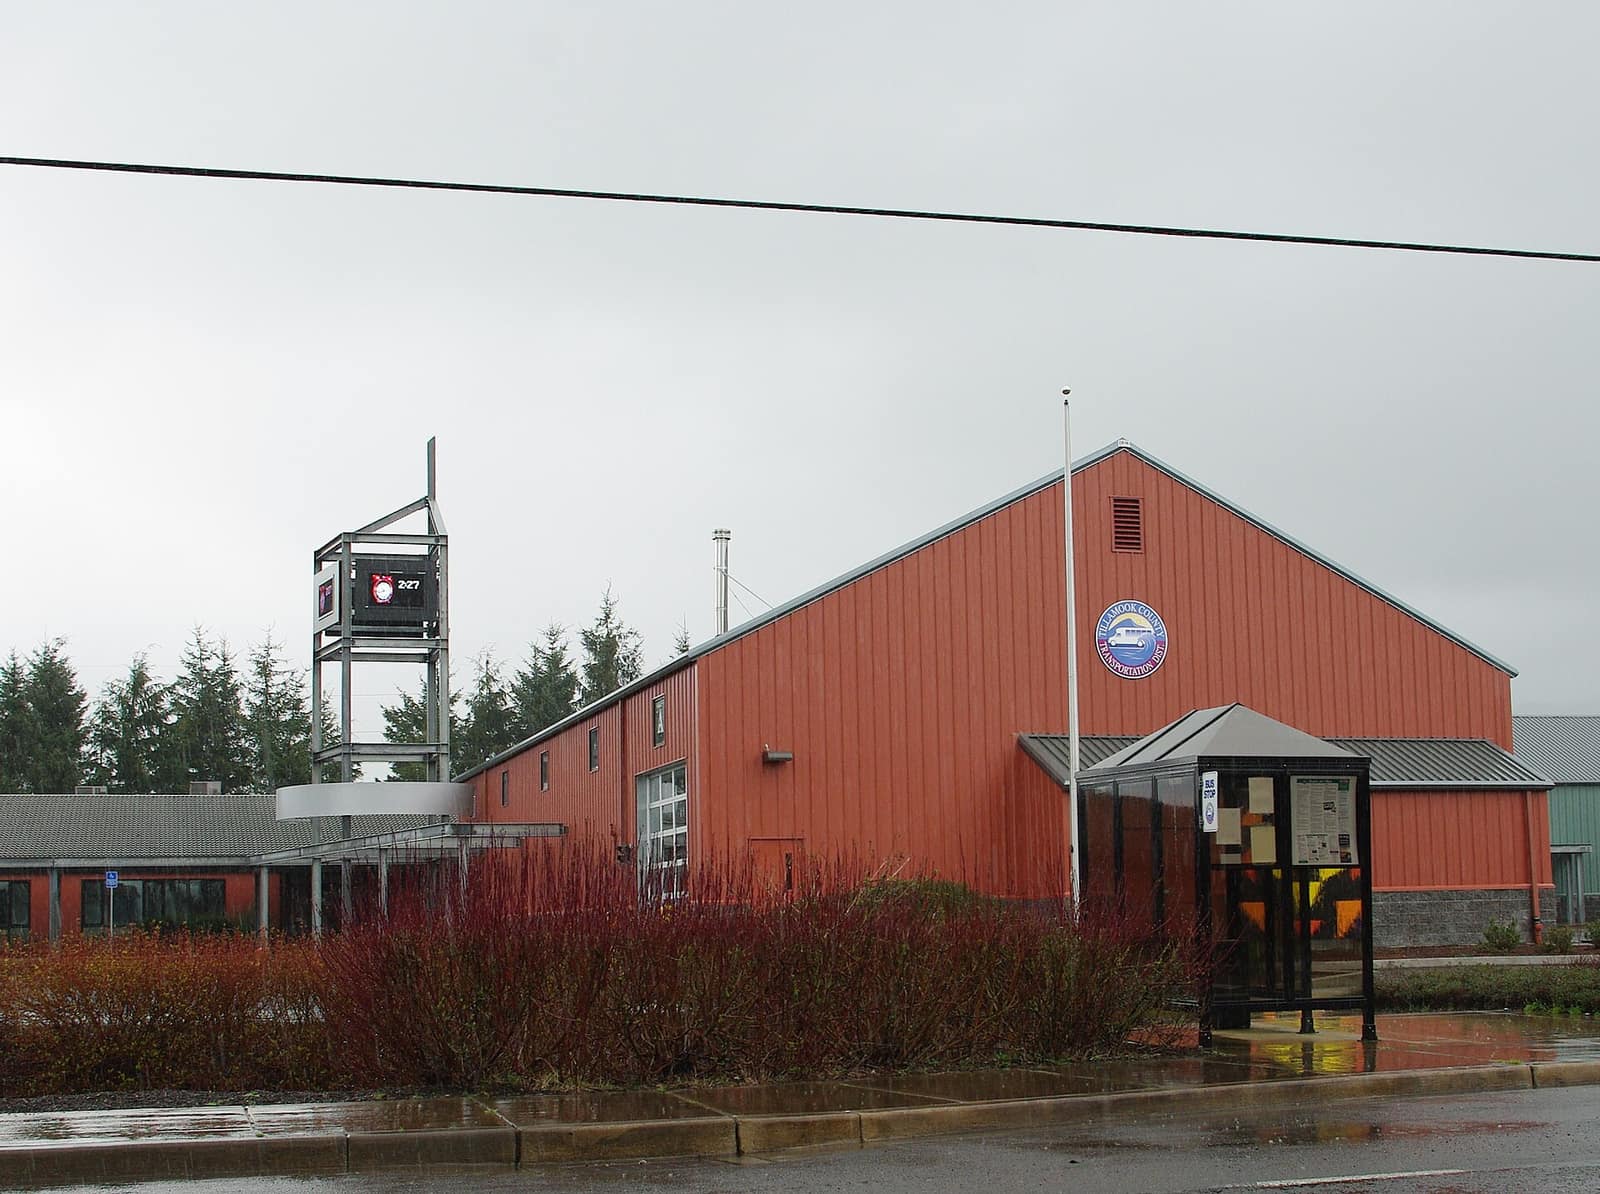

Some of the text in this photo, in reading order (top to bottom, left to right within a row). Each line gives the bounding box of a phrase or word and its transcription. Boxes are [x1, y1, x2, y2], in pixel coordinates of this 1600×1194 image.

[1098, 602, 1165, 638] TILLAMOOK COUNTY
[1099, 641, 1155, 676] TRANSPORTATION
[1203, 789, 1216, 799] STOP
[1205, 779, 1215, 789] BUS
